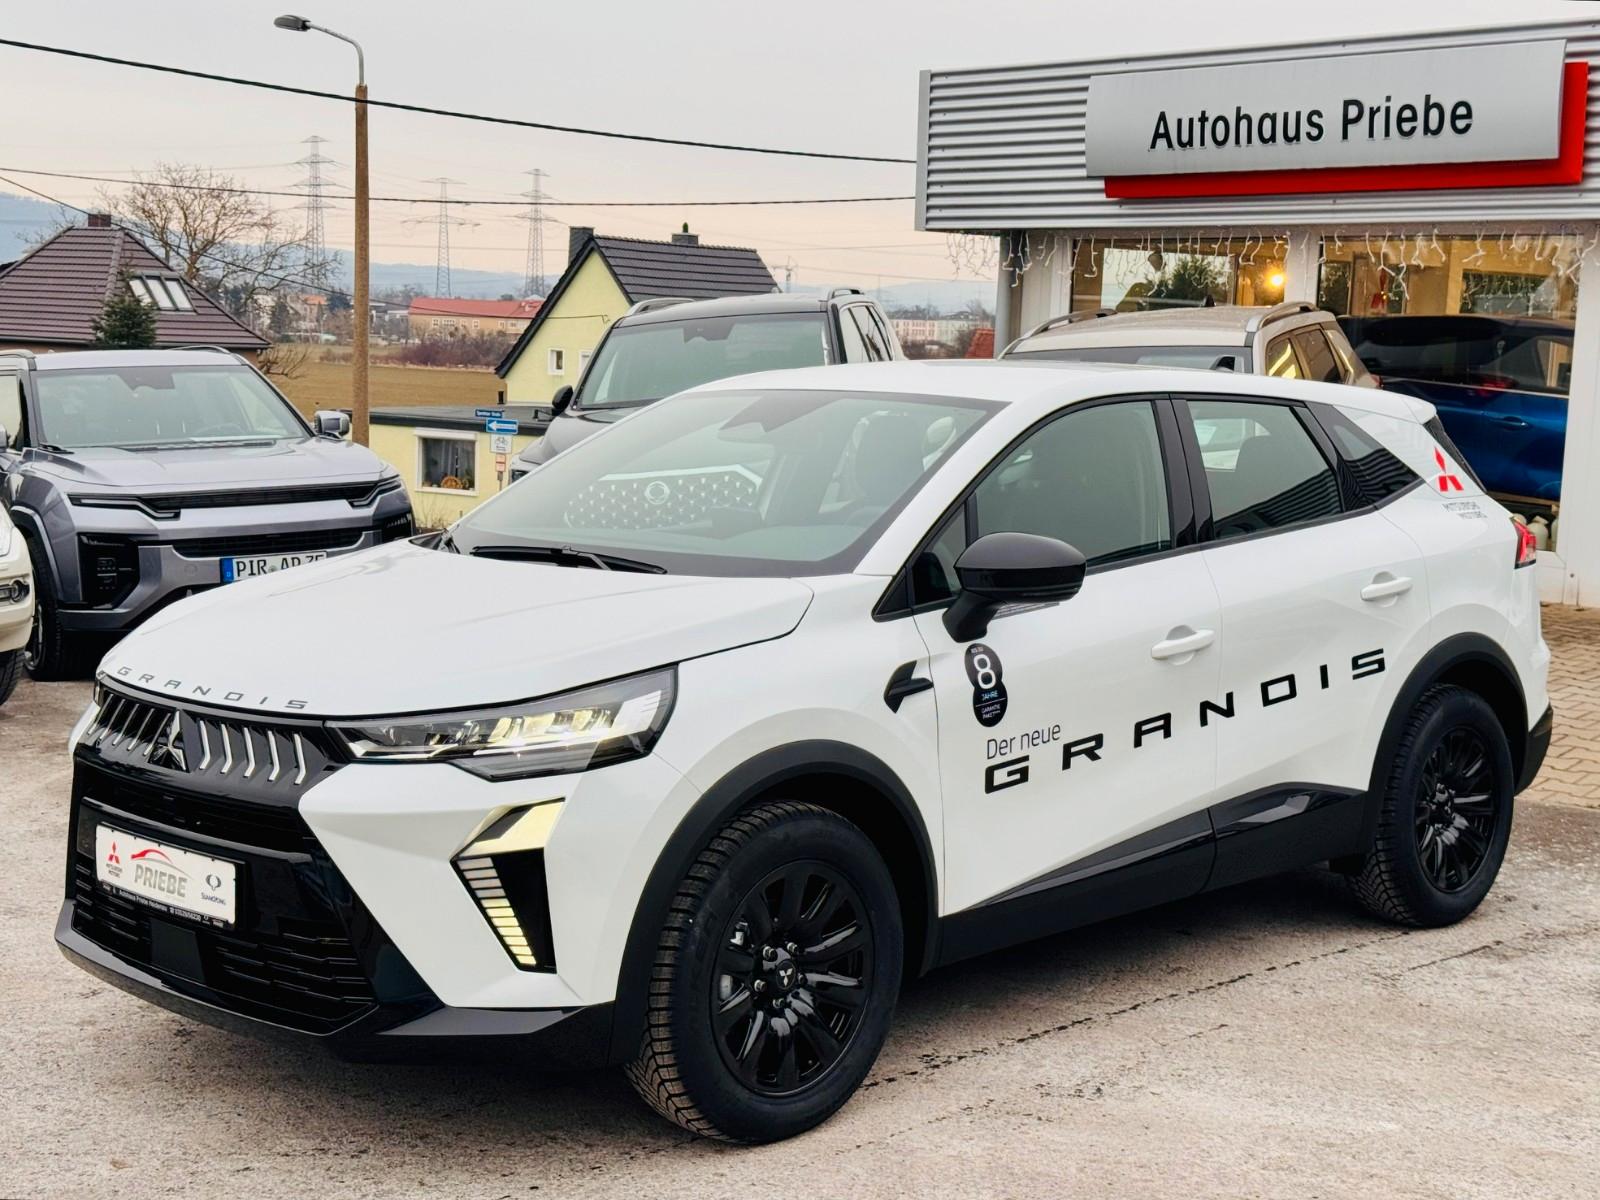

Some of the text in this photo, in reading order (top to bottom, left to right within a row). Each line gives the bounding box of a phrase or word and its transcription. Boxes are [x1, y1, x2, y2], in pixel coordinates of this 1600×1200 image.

[1149, 94, 1473, 150] Autohaus Priebe
[236, 558, 267, 577] PIR
[116, 666, 309, 710] GRANDIS
[973, 653, 997, 690] 8
[981, 690, 999, 701] JAHRE
[984, 648, 1387, 795] GRANDIS
[986, 723, 1061, 760] Der neue
[133, 863, 188, 898] PRIEBE
